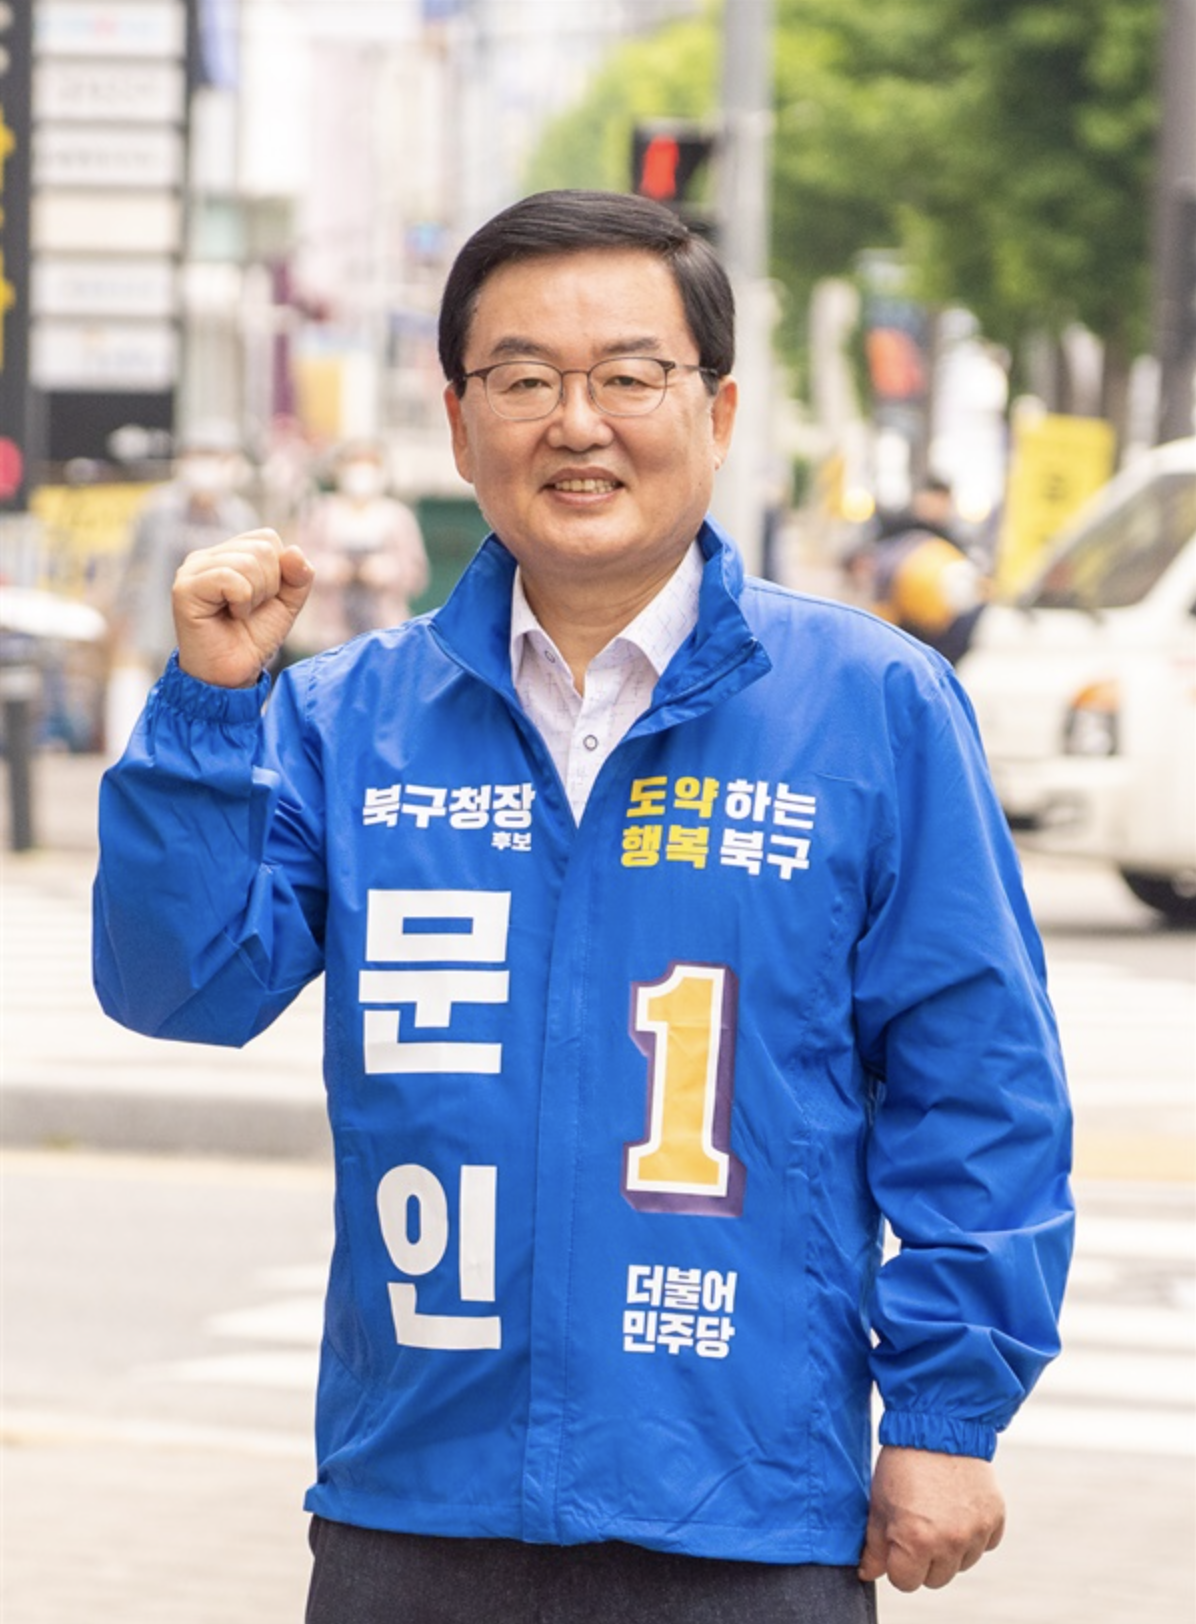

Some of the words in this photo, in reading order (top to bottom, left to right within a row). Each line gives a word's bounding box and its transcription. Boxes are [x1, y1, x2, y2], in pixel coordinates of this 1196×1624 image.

[362, 783, 535, 829] 북구청장
[491, 832, 532, 851] 후보
[621, 825, 709, 868] 행복
[720, 828, 810, 880] 북구
[626, 962, 742, 1212] 1
[626, 1265, 738, 1313] 더불어
[623, 1311, 735, 1359] 민주당
